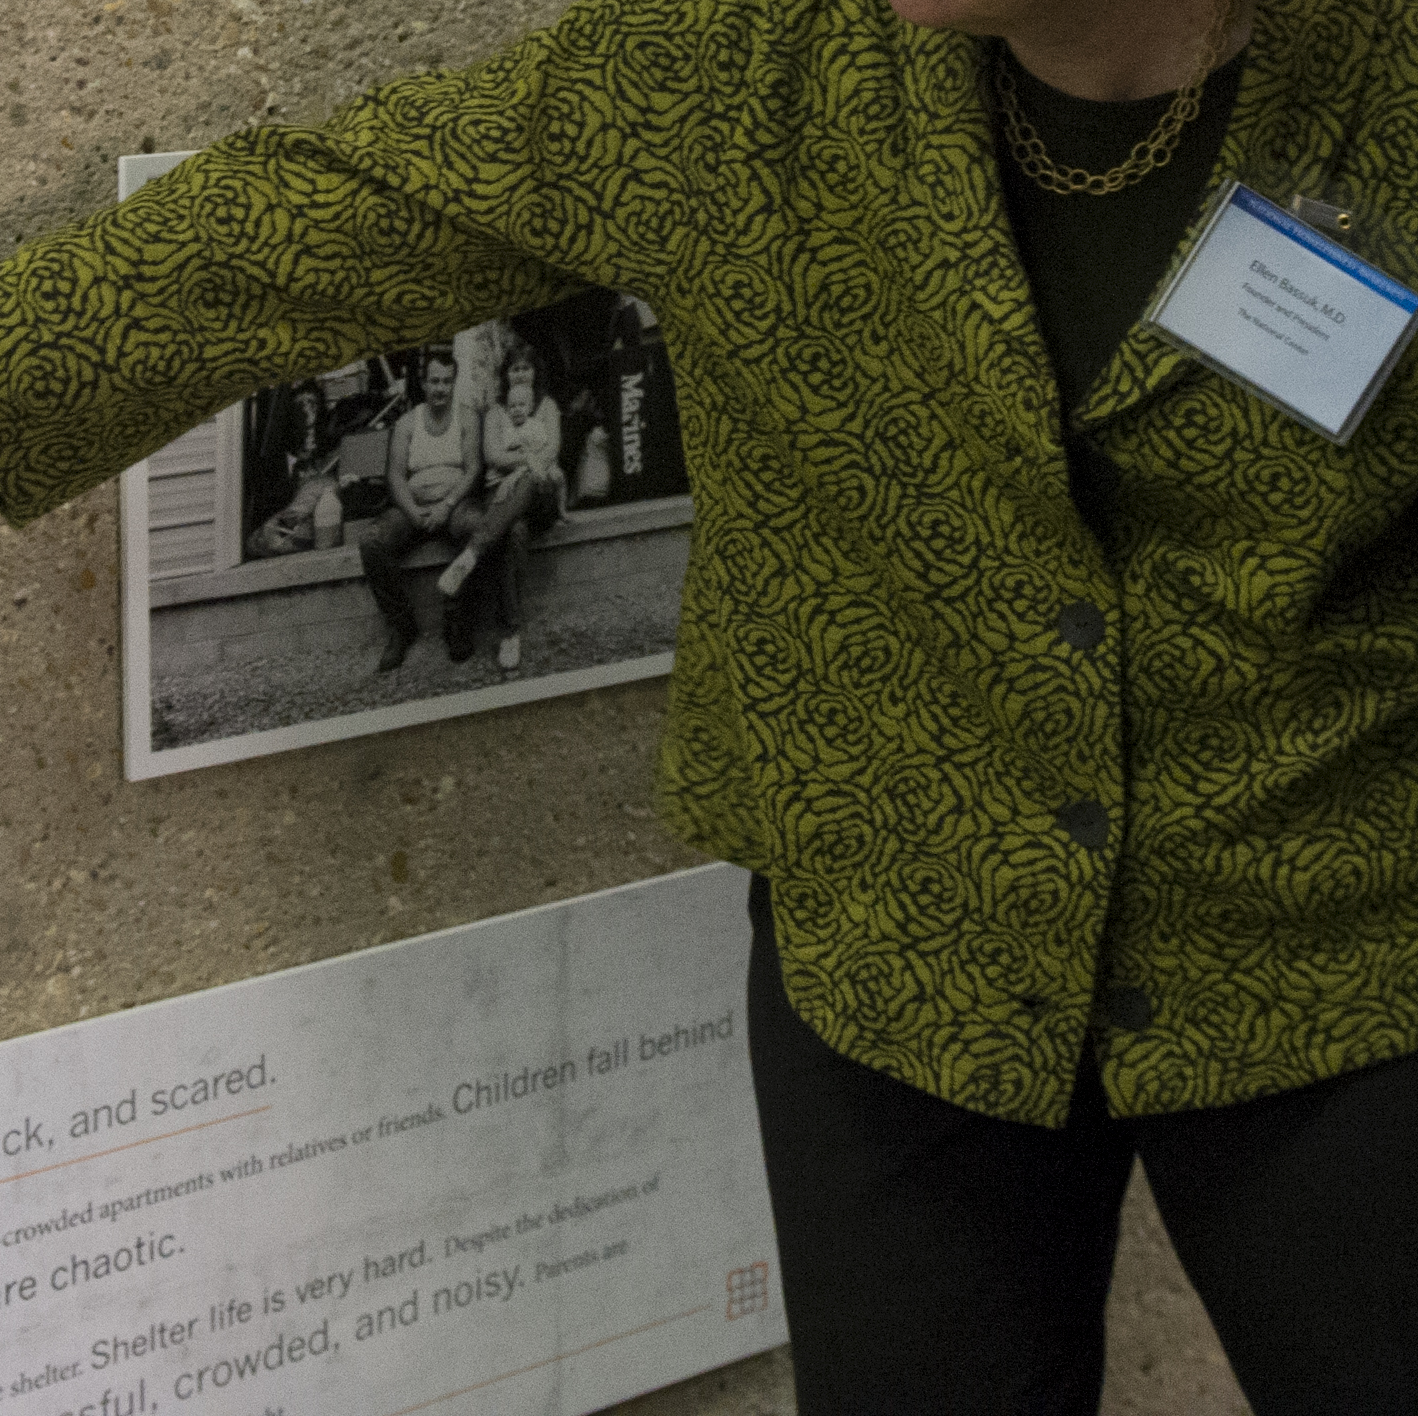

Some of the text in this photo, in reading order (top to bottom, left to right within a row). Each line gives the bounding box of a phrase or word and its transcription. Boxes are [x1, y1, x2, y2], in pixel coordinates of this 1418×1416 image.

[1249, 259, 1279, 283] Ellen
[621, 372, 646, 474] Marines
[69, 1088, 138, 1139] and
[150, 1053, 277, 1117] scared.
[98, 1170, 215, 1223] apartments
[220, 1154, 264, 1184] with
[268, 1136, 348, 1170] relatives
[350, 1126, 373, 1145] or
[451, 1058, 577, 1116] Children
[586, 1037, 631, 1077] fall
[638, 1008, 735, 1063] behind
[10, 1361, 83, 1398] shelter.
[90, 1315, 199, 1371] Shelter
[208, 1299, 253, 1333] life
[262, 1286, 287, 1315] is
[294, 1268, 356, 1305] very
[362, 1239, 433, 1283] hard.
[515, 1213, 545, 1235] the
[49, 1229, 185, 1291] chaotic.
[174, 1317, 341, 1401] crowded,
[354, 1288, 419, 1343] and
[432, 1263, 525, 1315] noisy.
